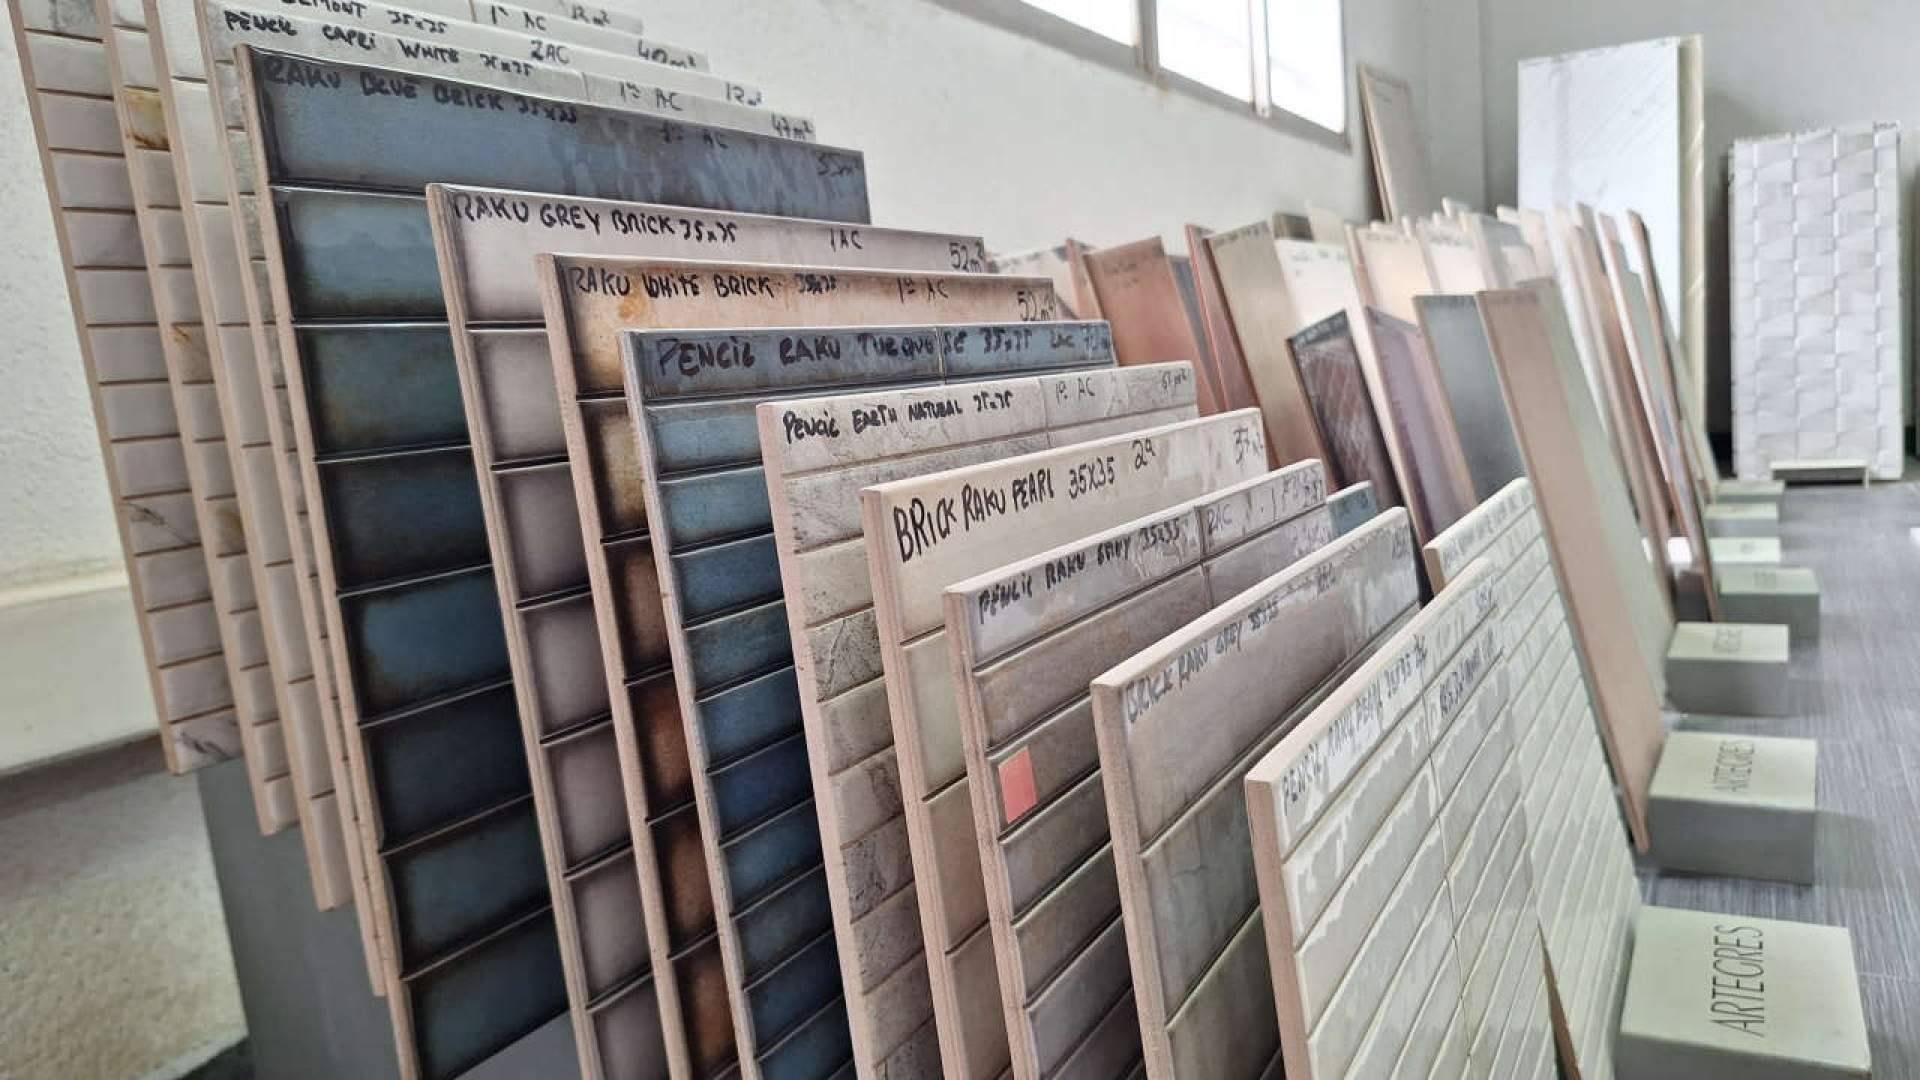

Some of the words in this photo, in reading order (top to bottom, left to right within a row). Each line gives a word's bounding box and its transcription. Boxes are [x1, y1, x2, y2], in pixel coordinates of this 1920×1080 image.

[523, 11, 547, 31] AC
[654, 87, 684, 112] AC
[451, 192, 529, 223] RAKU
[539, 202, 601, 235] GREY
[569, 266, 631, 297] RAKU
[926, 278, 949, 301] AC
[779, 335, 841, 366] RAKU
[852, 403, 898, 434] EARTH
[908, 399, 964, 422] NATURAL
[1078, 377, 1096, 400] AC
[962, 480, 1007, 532] RAKU
[1012, 466, 1056, 513] PEARL
[1045, 551, 1086, 590] RAKU
